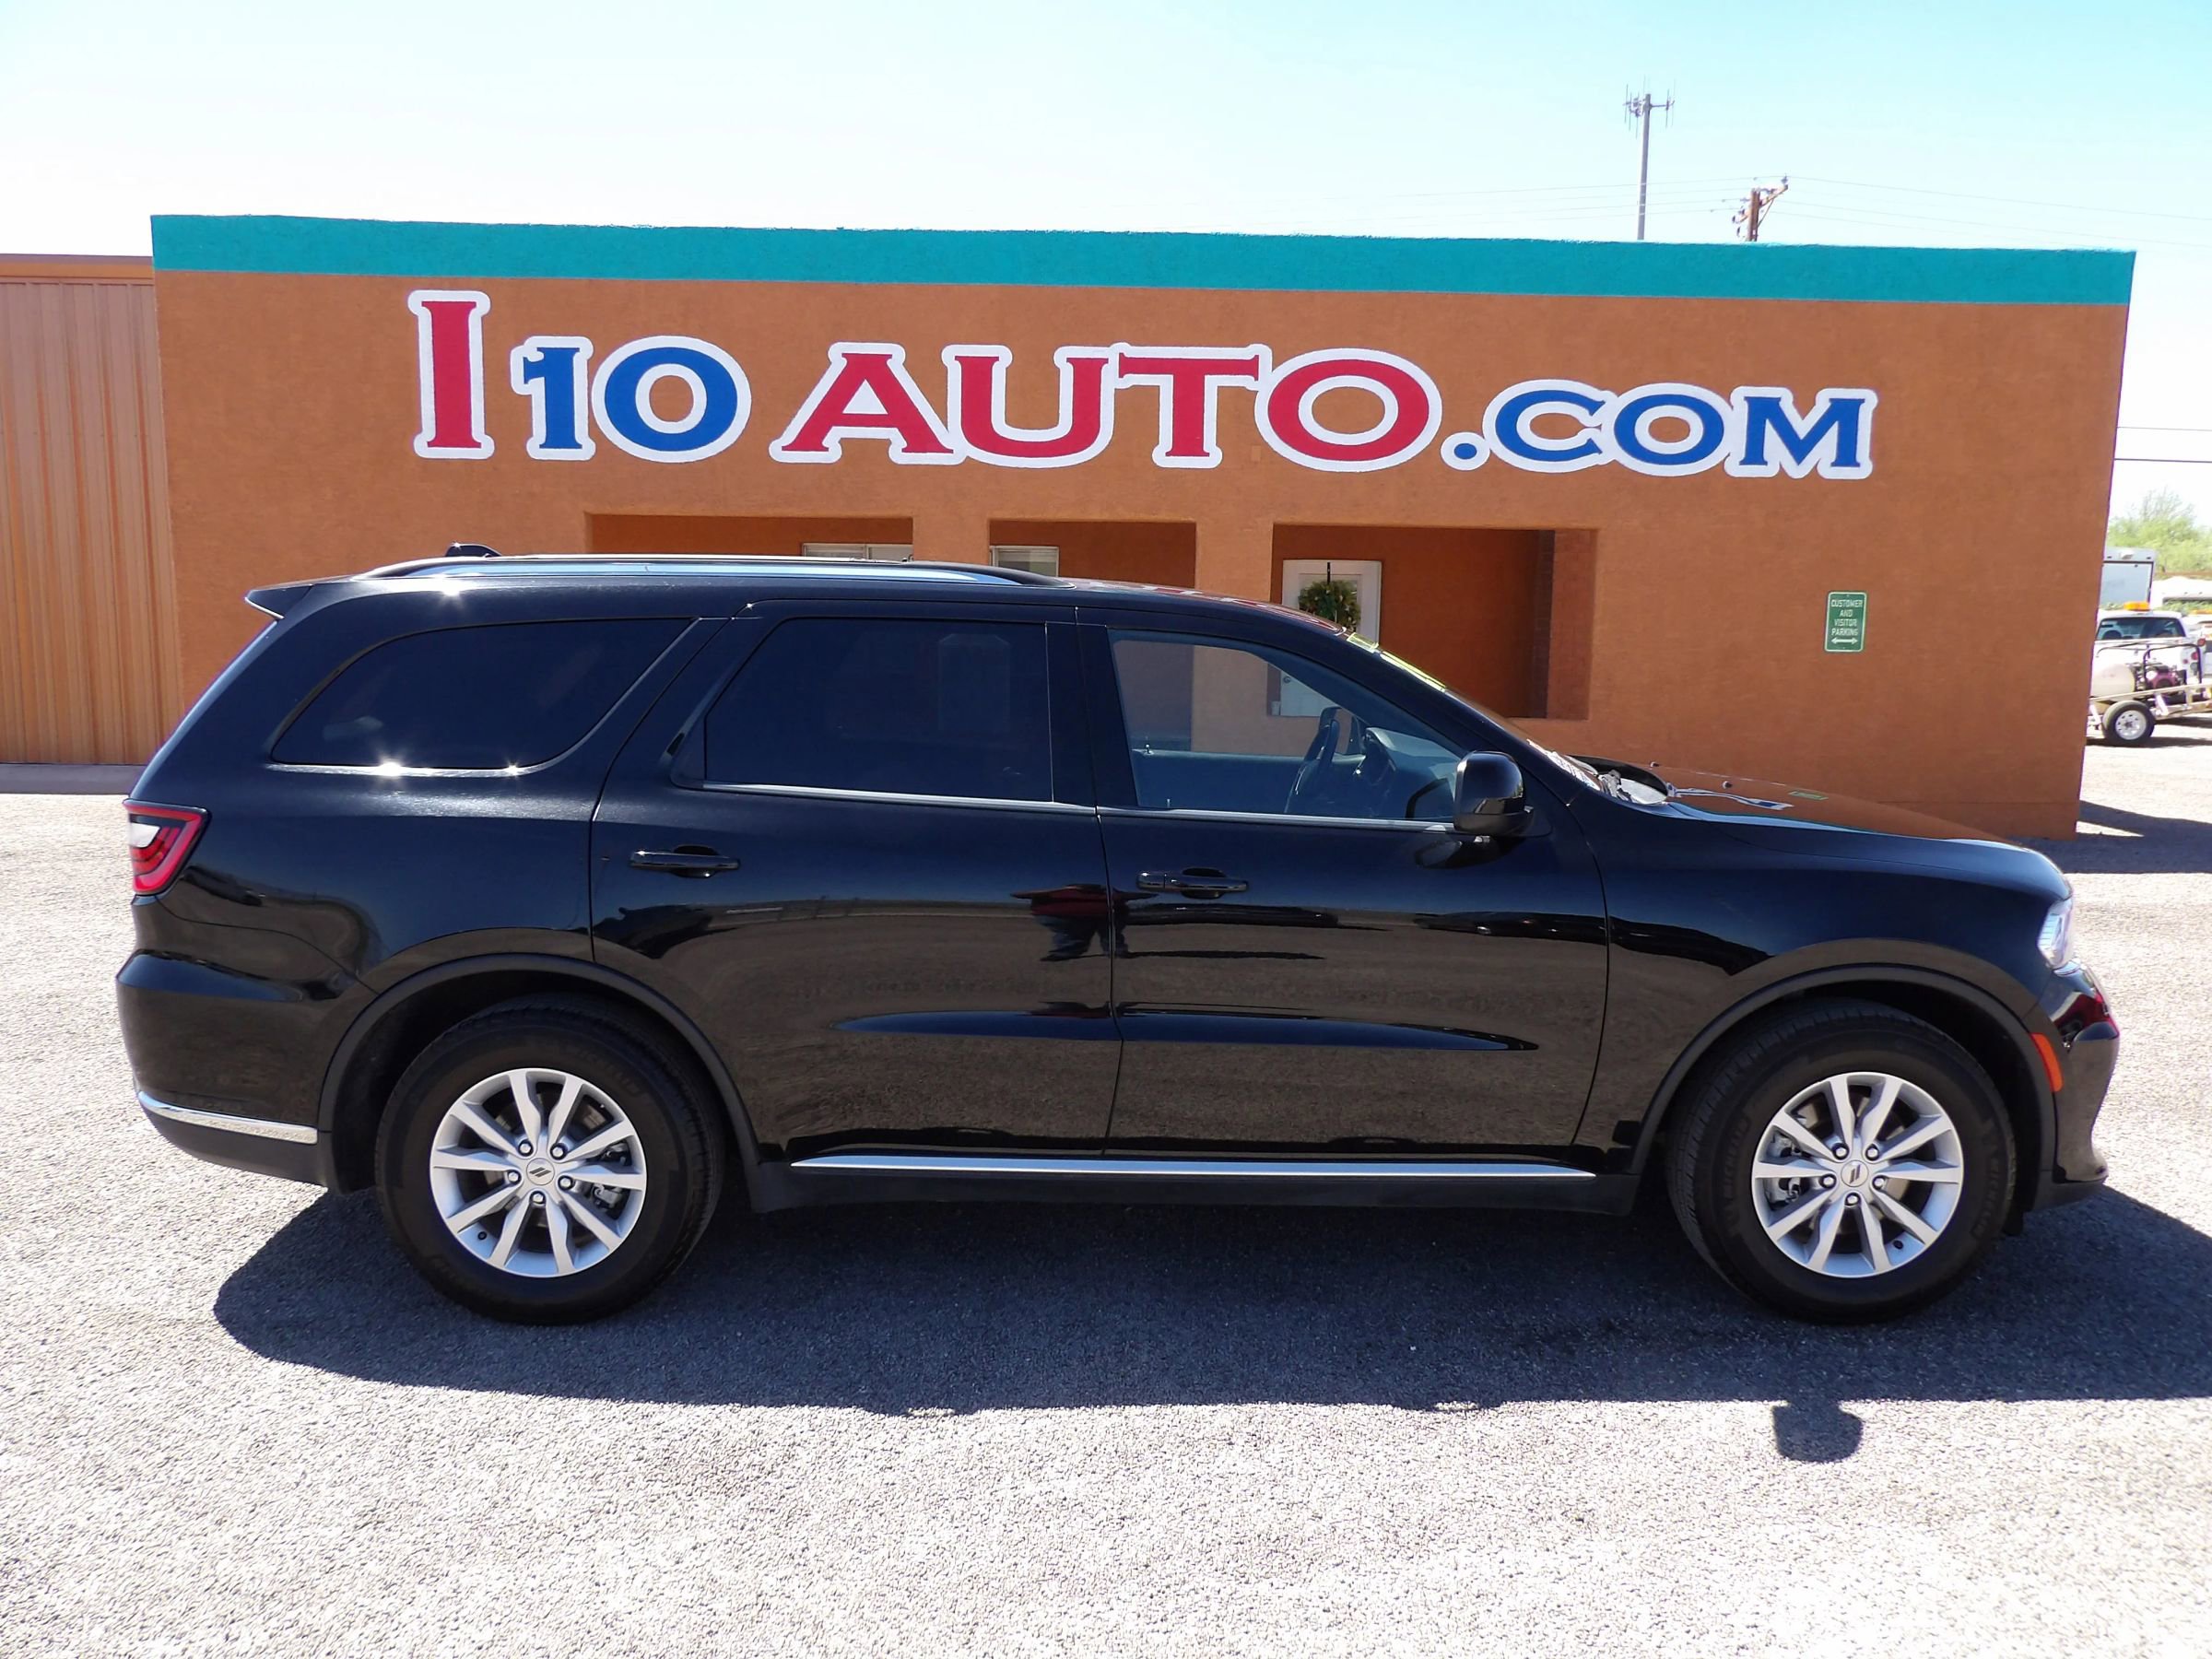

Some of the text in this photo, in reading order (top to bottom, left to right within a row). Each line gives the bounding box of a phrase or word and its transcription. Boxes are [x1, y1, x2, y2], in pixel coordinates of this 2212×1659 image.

[1830, 599, 1864, 608] CUSTOMER
[1839, 609, 1853, 618] AND
[1833, 618, 1858, 627] VISITOR
[1830, 628, 1859, 636] PARKING
